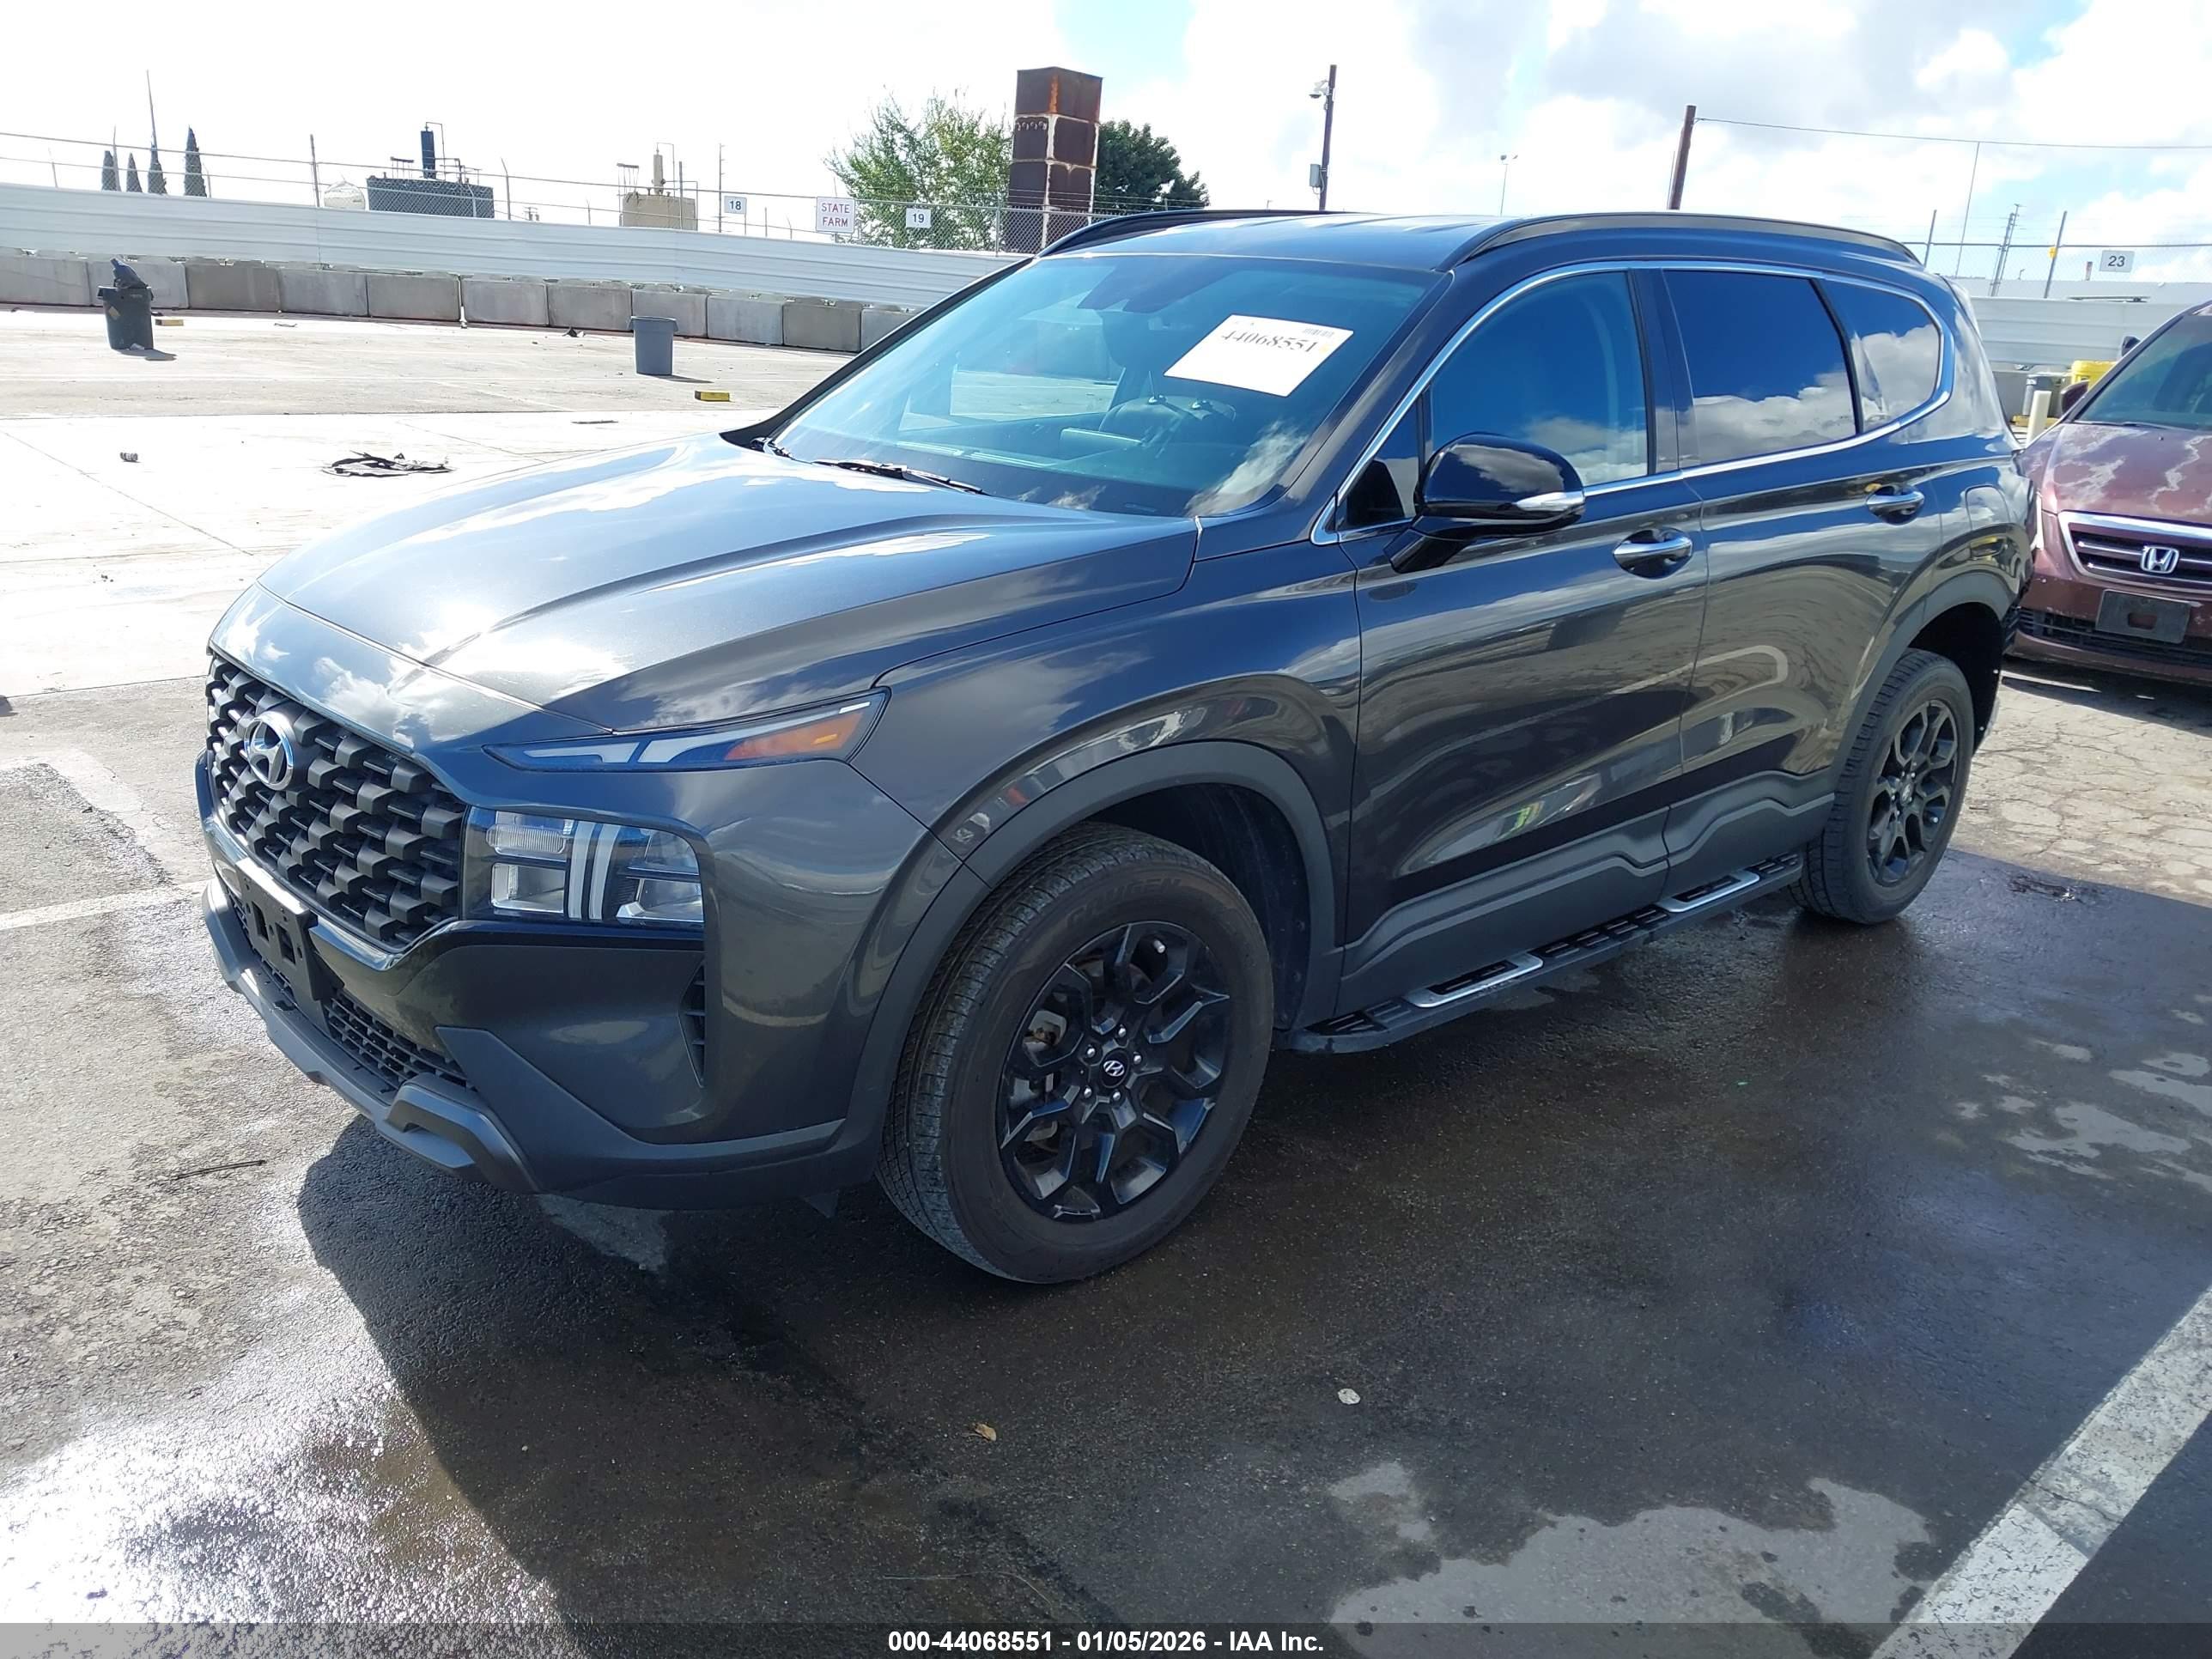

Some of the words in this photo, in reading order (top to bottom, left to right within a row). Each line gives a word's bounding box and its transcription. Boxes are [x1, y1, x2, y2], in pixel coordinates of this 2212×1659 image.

[729, 200, 742, 210] 18
[821, 202, 850, 214] STATE
[822, 216, 848, 228] FARM
[912, 213, 925, 223] 19
[2107, 255, 2126, 268] 23
[1221, 330, 1318, 352] 44068551
